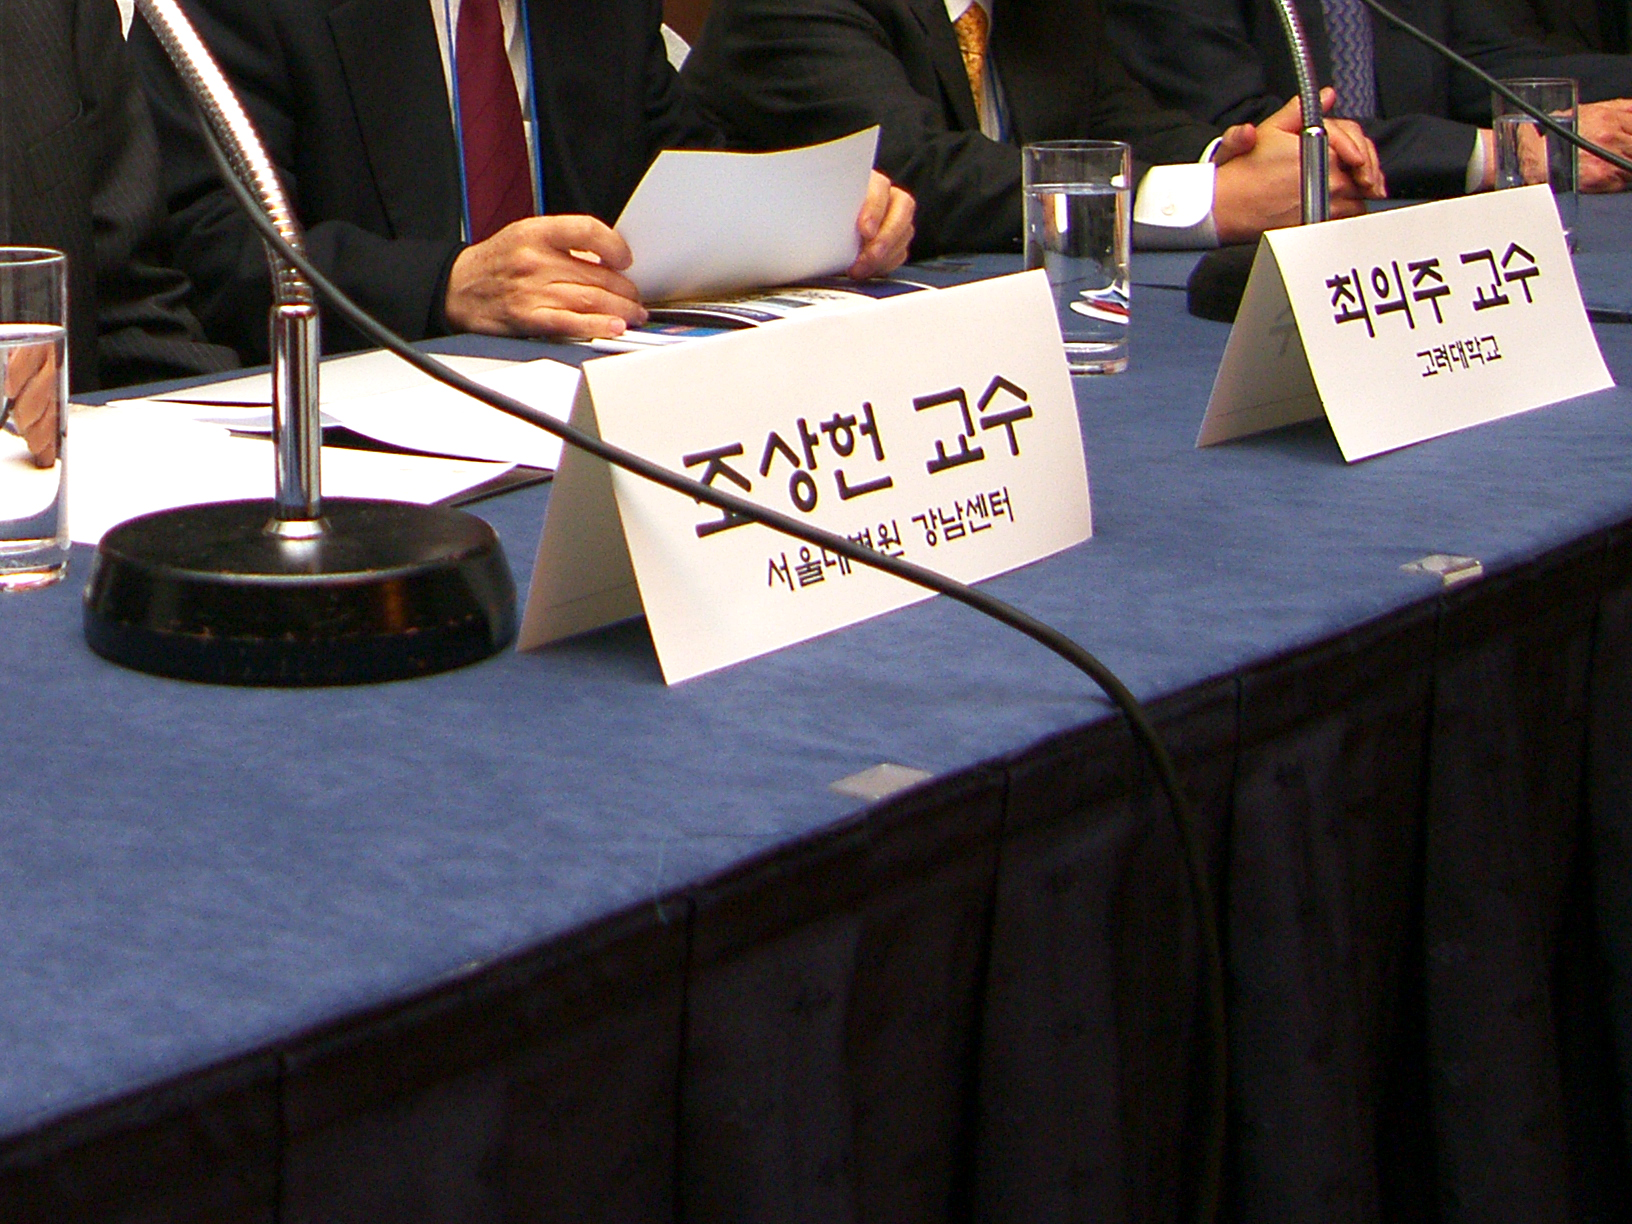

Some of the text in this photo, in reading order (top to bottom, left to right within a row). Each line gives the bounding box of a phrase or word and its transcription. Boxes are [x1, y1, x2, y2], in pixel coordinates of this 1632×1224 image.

[1325, 257, 1451, 338] 최의주
[1459, 242, 1540, 311] 교수
[1416, 335, 1502, 378] 고려대학교
[682, 375, 1034, 539] 조상헌 교수
[911, 486, 1015, 547] 강남센터
